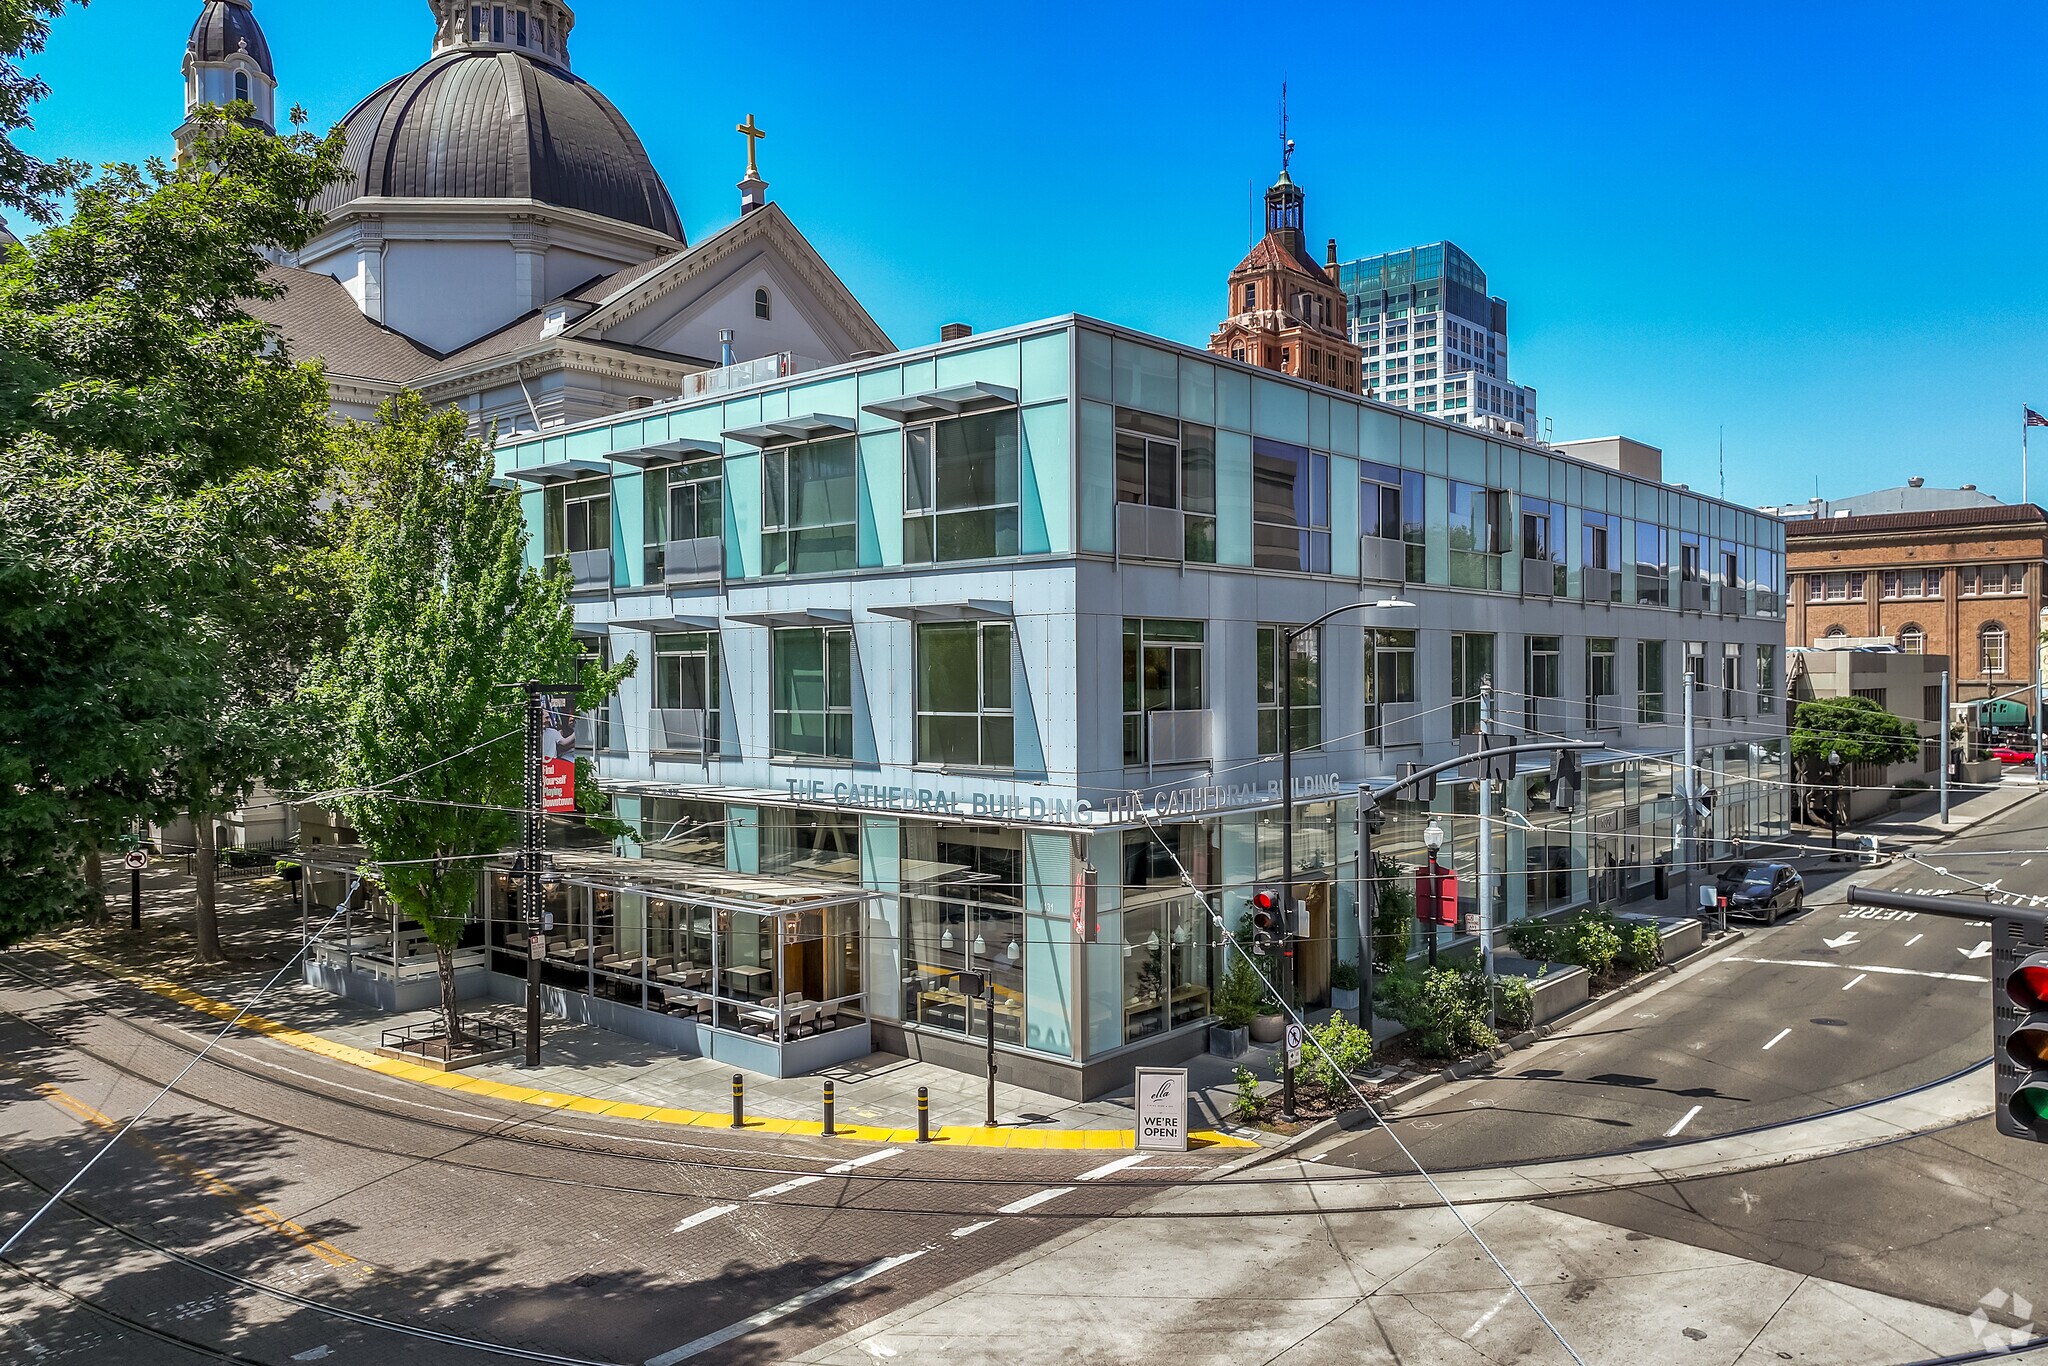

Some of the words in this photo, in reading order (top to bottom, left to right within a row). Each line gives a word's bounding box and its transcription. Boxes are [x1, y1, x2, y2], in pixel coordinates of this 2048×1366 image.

[542, 797, 574, 808] Downtown
[785, 778, 825, 803] THE
[833, 782, 964, 815] CATHEDRAL
[971, 792, 1094, 826] BUILDING
[1103, 793, 1144, 823] THE
[1154, 783, 1258, 817] CATHEDRAL
[1839, 906, 1919, 922] HERE
[1151, 1079, 1175, 1101] ella
[1143, 1116, 1178, 1127] WE'RE
[1143, 1127, 1178, 1138] OPEN!
